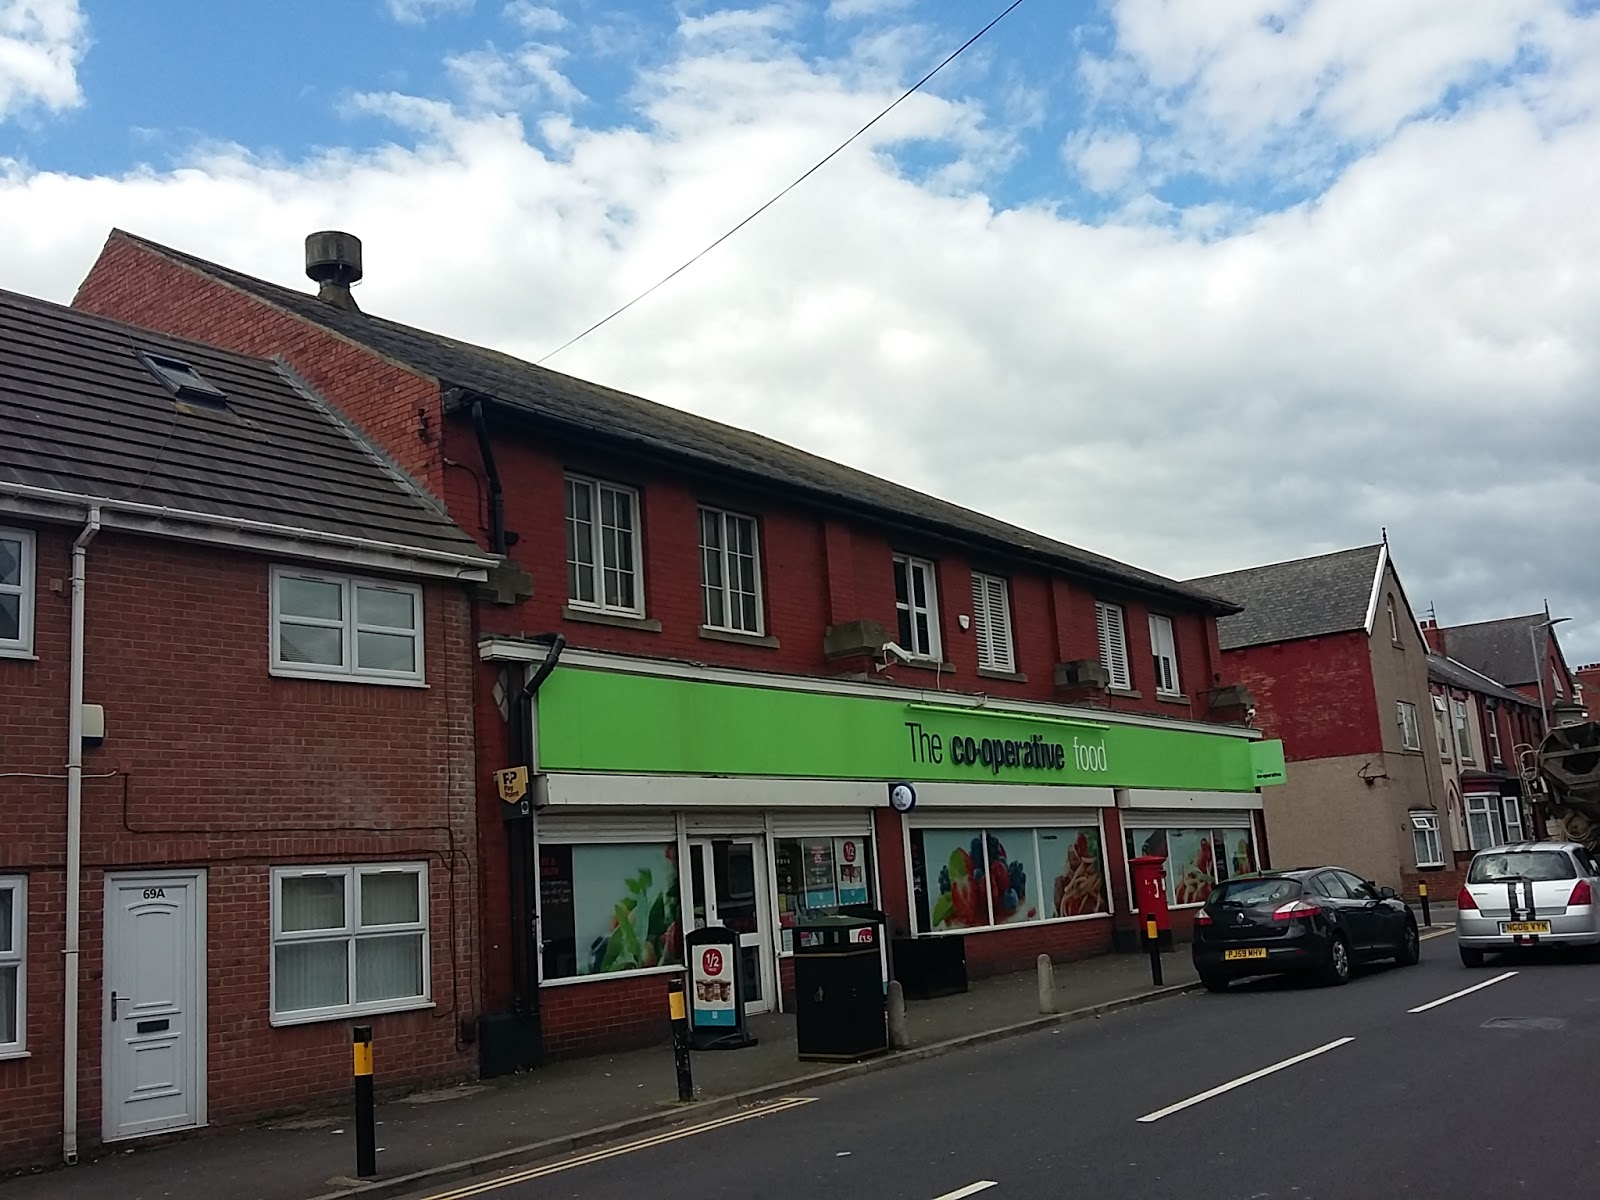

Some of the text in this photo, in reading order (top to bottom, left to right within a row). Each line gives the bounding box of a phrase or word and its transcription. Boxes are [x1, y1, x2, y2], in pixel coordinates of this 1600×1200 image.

[905, 722, 1108, 775] The co-operative food
[143, 888, 166, 899] 69A
[1506, 921, 1548, 931] NG06 VYK
[1228, 949, 1247, 958] PJ59
[706, 952, 720, 967] 1/2
